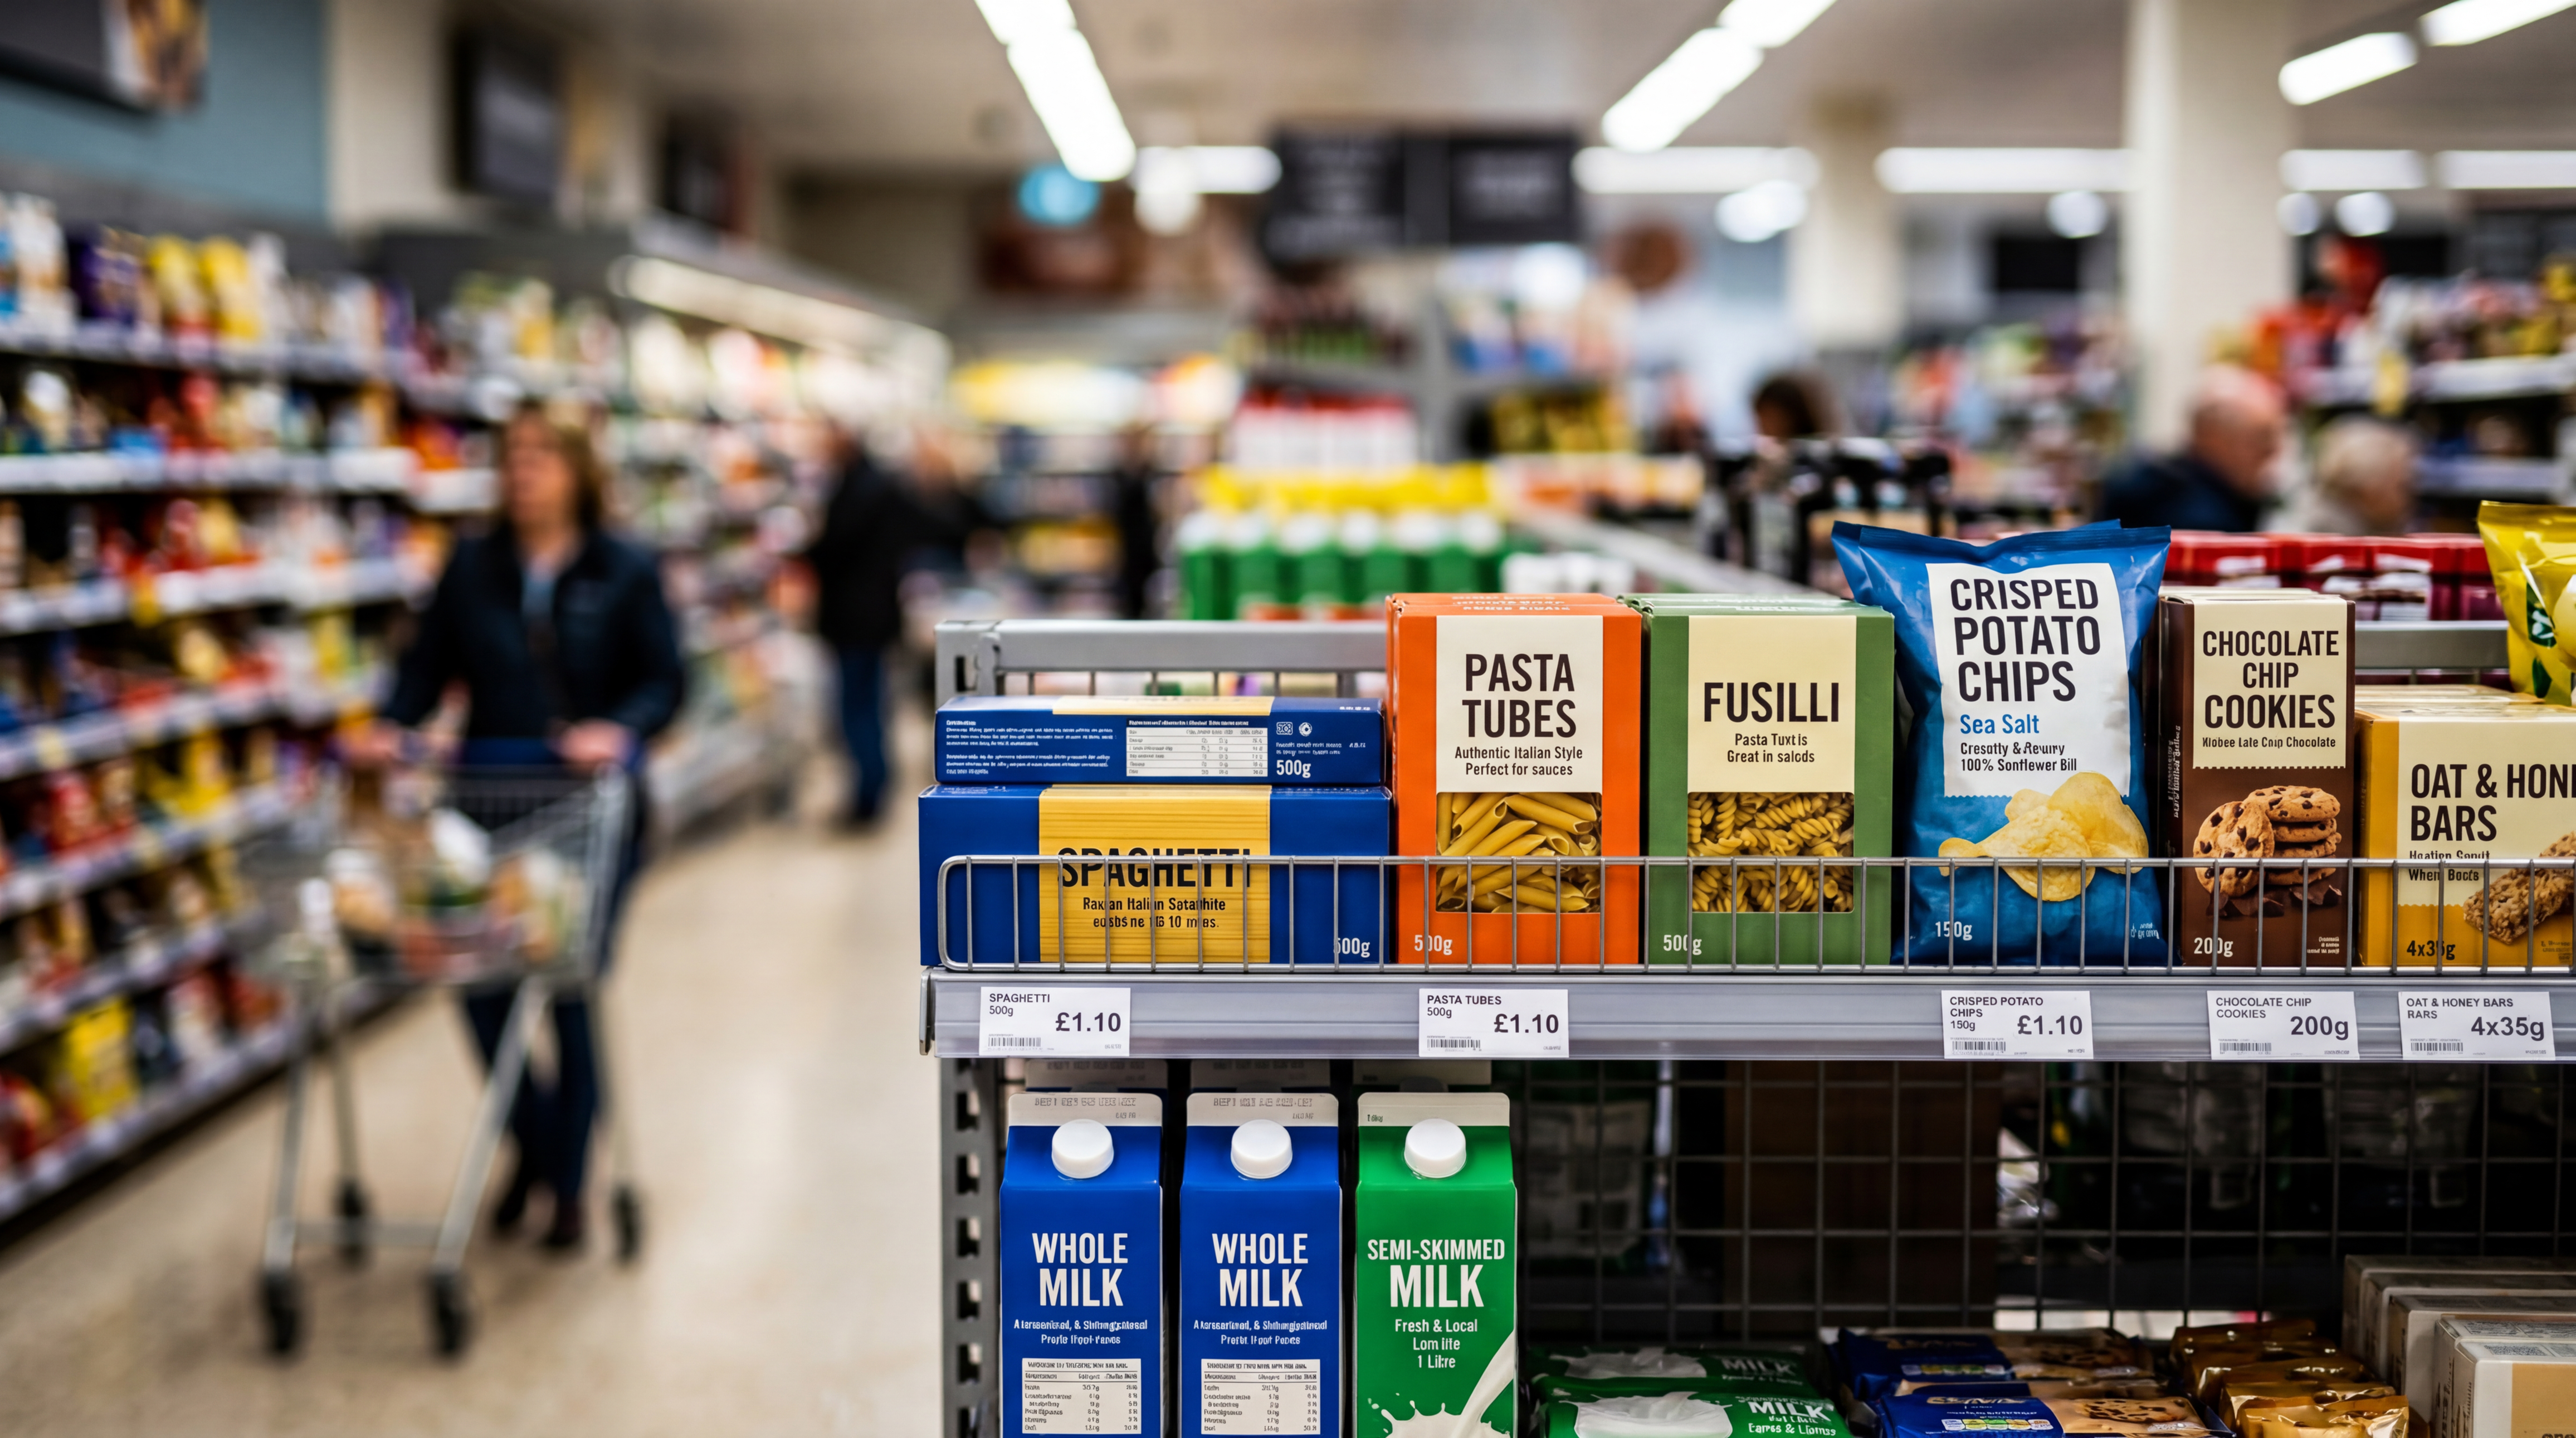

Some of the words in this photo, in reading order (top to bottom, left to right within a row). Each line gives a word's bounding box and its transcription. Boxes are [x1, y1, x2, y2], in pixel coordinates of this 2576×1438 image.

[1950, 579, 2099, 610] CRISPED
[1954, 616, 2100, 655] POTATO
[2203, 631, 2339, 656] CHOCOLATE
[1466, 654, 1575, 692] PASTA
[1958, 660, 2076, 702] CHIPS
[2243, 662, 2299, 688] CHIP
[1704, 682, 1839, 722] FUSILLI
[2205, 695, 2335, 728] COOKIES
[1462, 699, 1576, 738] TUBES
[1960, 714, 1995, 734] Sea
[2002, 714, 2040, 734] Salt
[1735, 733, 1768, 746] Pasta
[2012, 742, 2021, 755] &
[1455, 746, 1510, 759] Authentic
[1515, 746, 1551, 759] Italian
[1554, 746, 1583, 761] Style
[1727, 750, 1759, 763] Great
[1763, 750, 1773, 762] in
[1276, 760, 1311, 778] 500g
[1465, 763, 1509, 776] Perfect
[1512, 763, 1529, 775] for
[1532, 764, 1573, 776] sauces
[1961, 758, 1994, 771] 100%
[2411, 764, 2467, 798] OAT
[2475, 763, 2497, 798] &
[2411, 805, 2497, 841] BARS
[1935, 921, 1973, 941] 150g
[989, 993, 1050, 1002] SPAGHETTI
[1427, 995, 1463, 1004] PASTA
[1465, 996, 1502, 1005] TUBES
[1950, 997, 1998, 1005] CRISPED
[2001, 997, 2043, 1006] POTATO
[2216, 998, 2283, 1006] CHOCOLATE
[2286, 998, 2312, 1006] CHIP
[2406, 998, 2428, 1007] OAT
[2431, 998, 2439, 1007] &
[2442, 998, 2480, 1007] HONEY
[2483, 998, 2513, 1007] BARS
[989, 1005, 1014, 1017] 500g
[1427, 1007, 1452, 1019] 500g
[1950, 1009, 1983, 1017] CHIPS
[2217, 1009, 2266, 1018] COOKIES
[2408, 1010, 2437, 1019] RARS
[1055, 1012, 1121, 1032] £1.10
[1493, 1013, 1559, 1034] £1.10
[1950, 1020, 1976, 1031] 150g
[2017, 1015, 2083, 1035] £1.10
[2290, 1016, 2349, 1041] 200g
[2471, 1016, 2545, 1042] 4x35g
[1032, 1233, 1128, 1264] WHOLE
[1212, 1233, 1309, 1264] WHOLE
[1367, 1239, 1505, 1260] SEMI-SKIMMED
[1039, 1269, 1124, 1306] MILK
[1220, 1269, 1303, 1307] MILK
[1390, 1265, 1485, 1307] MILK
[1395, 1319, 1429, 1332] Fresh
[1433, 1319, 1442, 1332] &
[1445, 1319, 1478, 1332] Local
[1747, 1401, 1831, 1422] MILK
